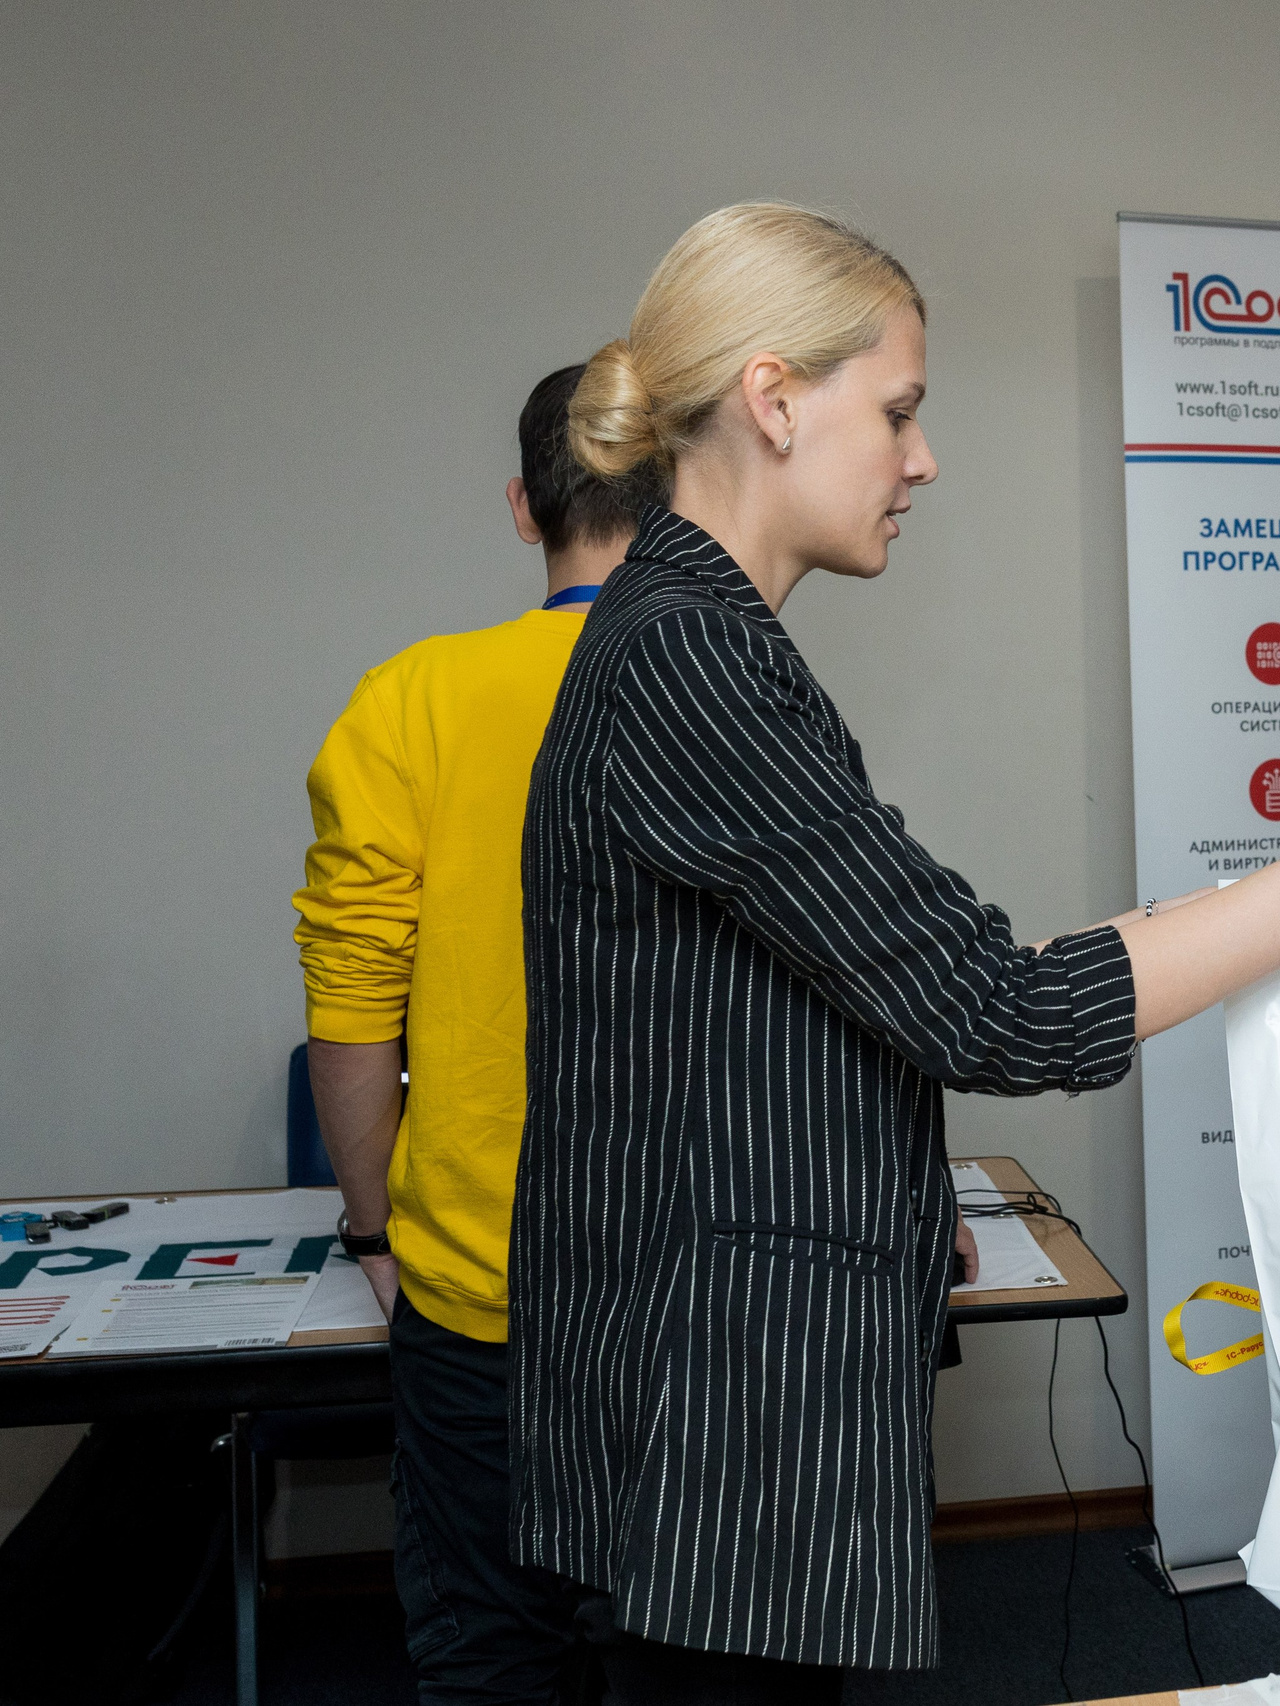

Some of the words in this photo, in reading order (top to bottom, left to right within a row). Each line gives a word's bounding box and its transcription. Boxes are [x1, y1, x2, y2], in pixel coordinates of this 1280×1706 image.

[1174, 335, 1239, 348] программы
[1243, 338, 1250, 347] в
[1175, 381, 1280, 397] www.1soft.ru
[1209, 859, 1219, 871] И
